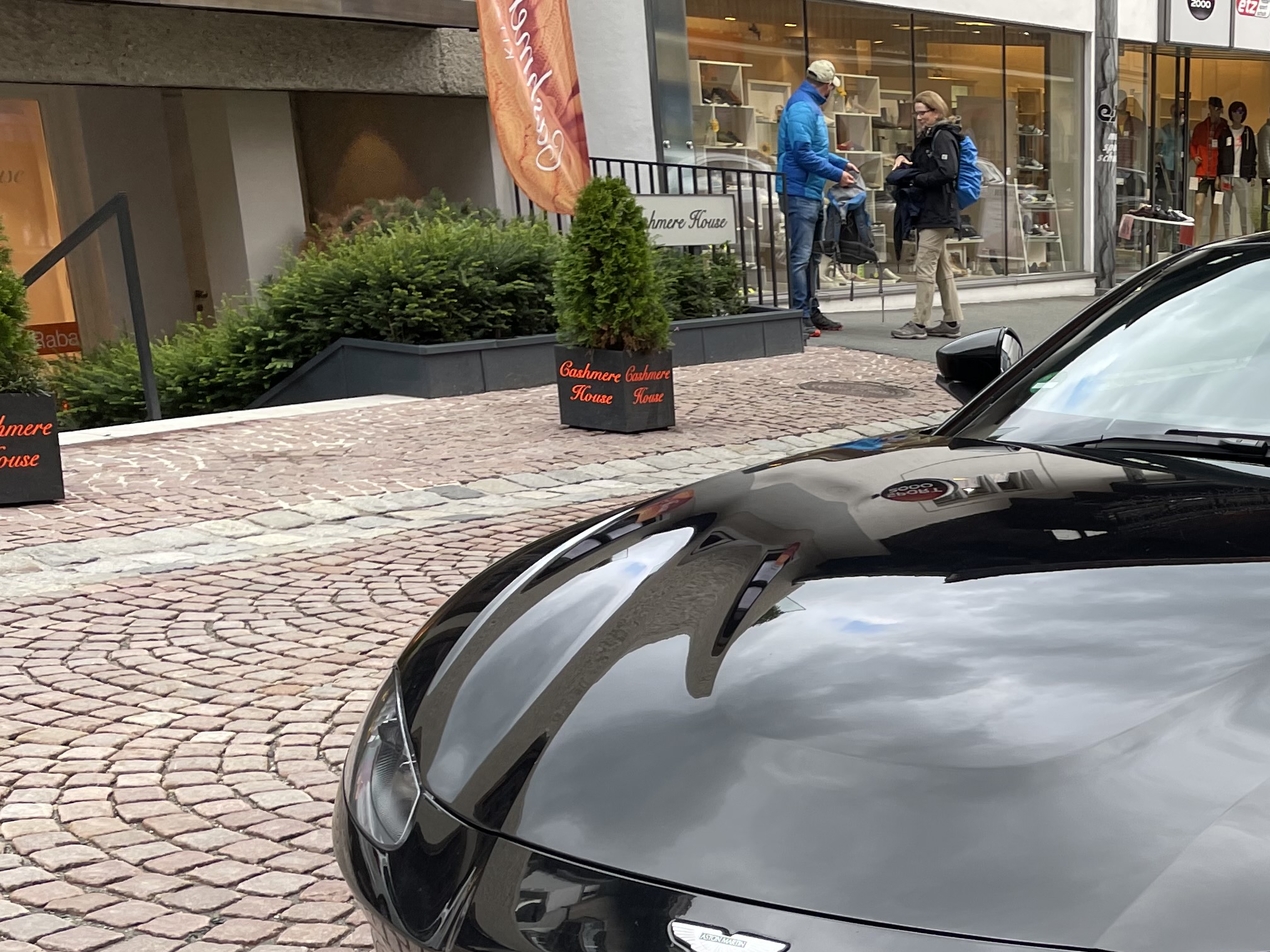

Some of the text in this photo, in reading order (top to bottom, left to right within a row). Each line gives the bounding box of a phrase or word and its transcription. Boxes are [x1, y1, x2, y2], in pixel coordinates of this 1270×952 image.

[688, 209, 728, 228] House
[559, 360, 622, 383] Cashmere
[625, 364, 671, 382] Cashmere
[570, 384, 614, 405] House
[632, 386, 665, 405] House
